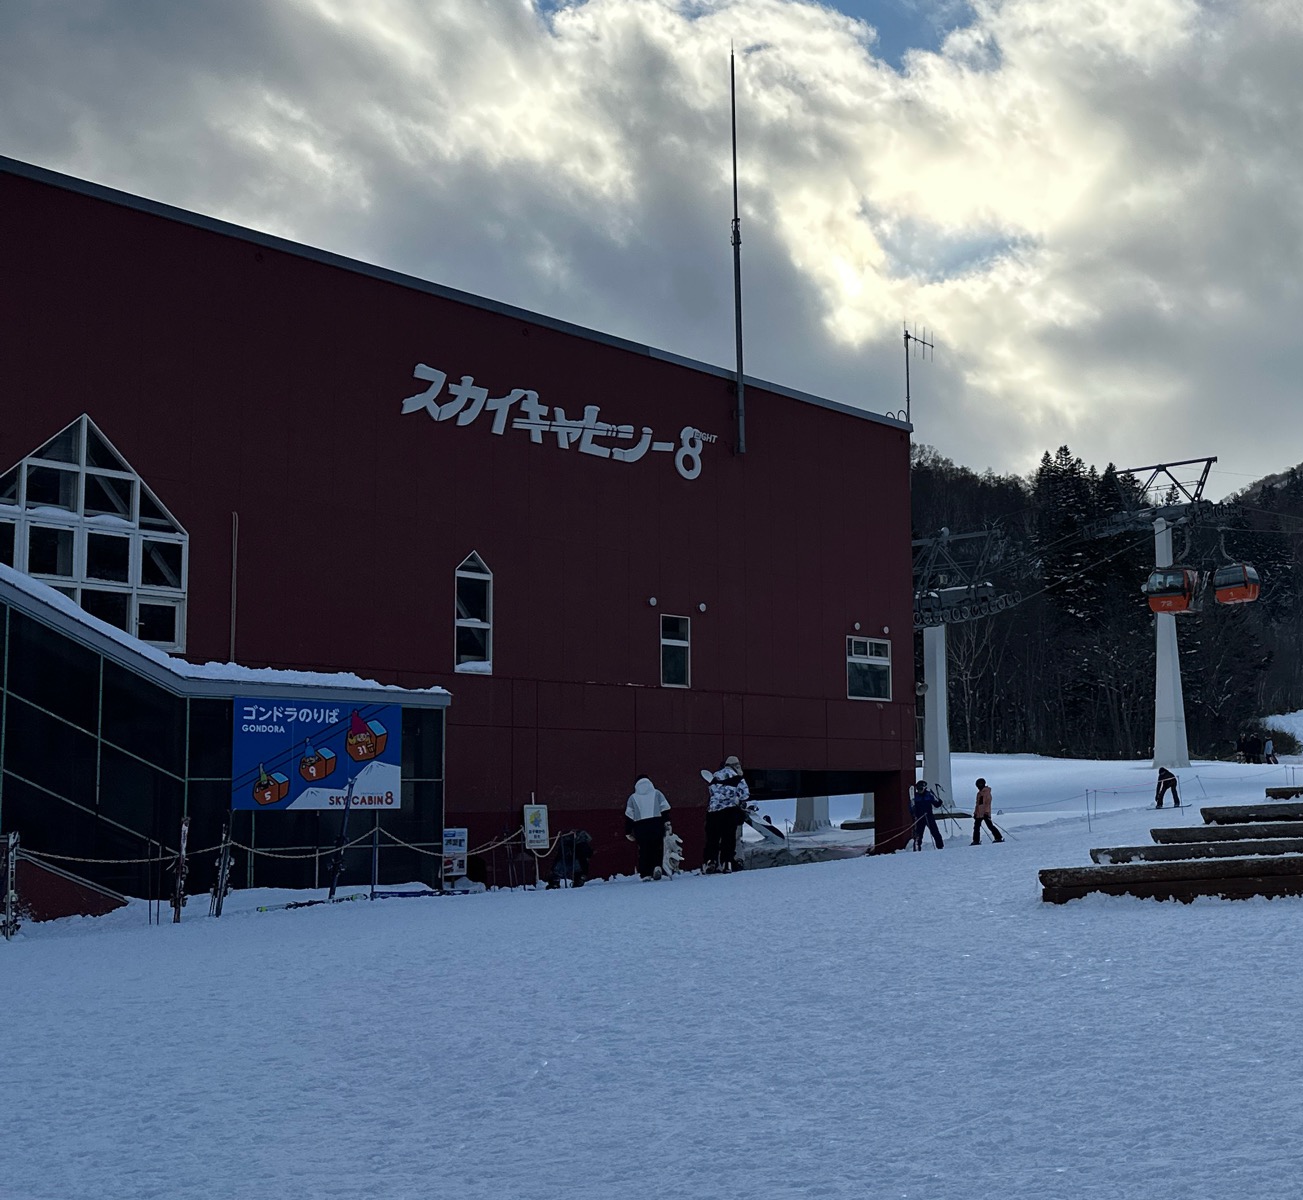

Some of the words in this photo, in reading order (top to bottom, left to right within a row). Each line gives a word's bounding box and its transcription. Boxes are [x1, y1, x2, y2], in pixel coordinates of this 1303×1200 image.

[693, 431, 718, 443] EIGHT
[243, 704, 340, 724] ゴンドラのりば
[241, 724, 285, 733] GONDORA
[357, 745, 367, 755] 31
[308, 766, 316, 777] 9
[264, 791, 271, 801] 5
[328, 796, 347, 805] SKY
[352, 796, 383, 805] CABIN
[384, 791, 394, 805] 8
